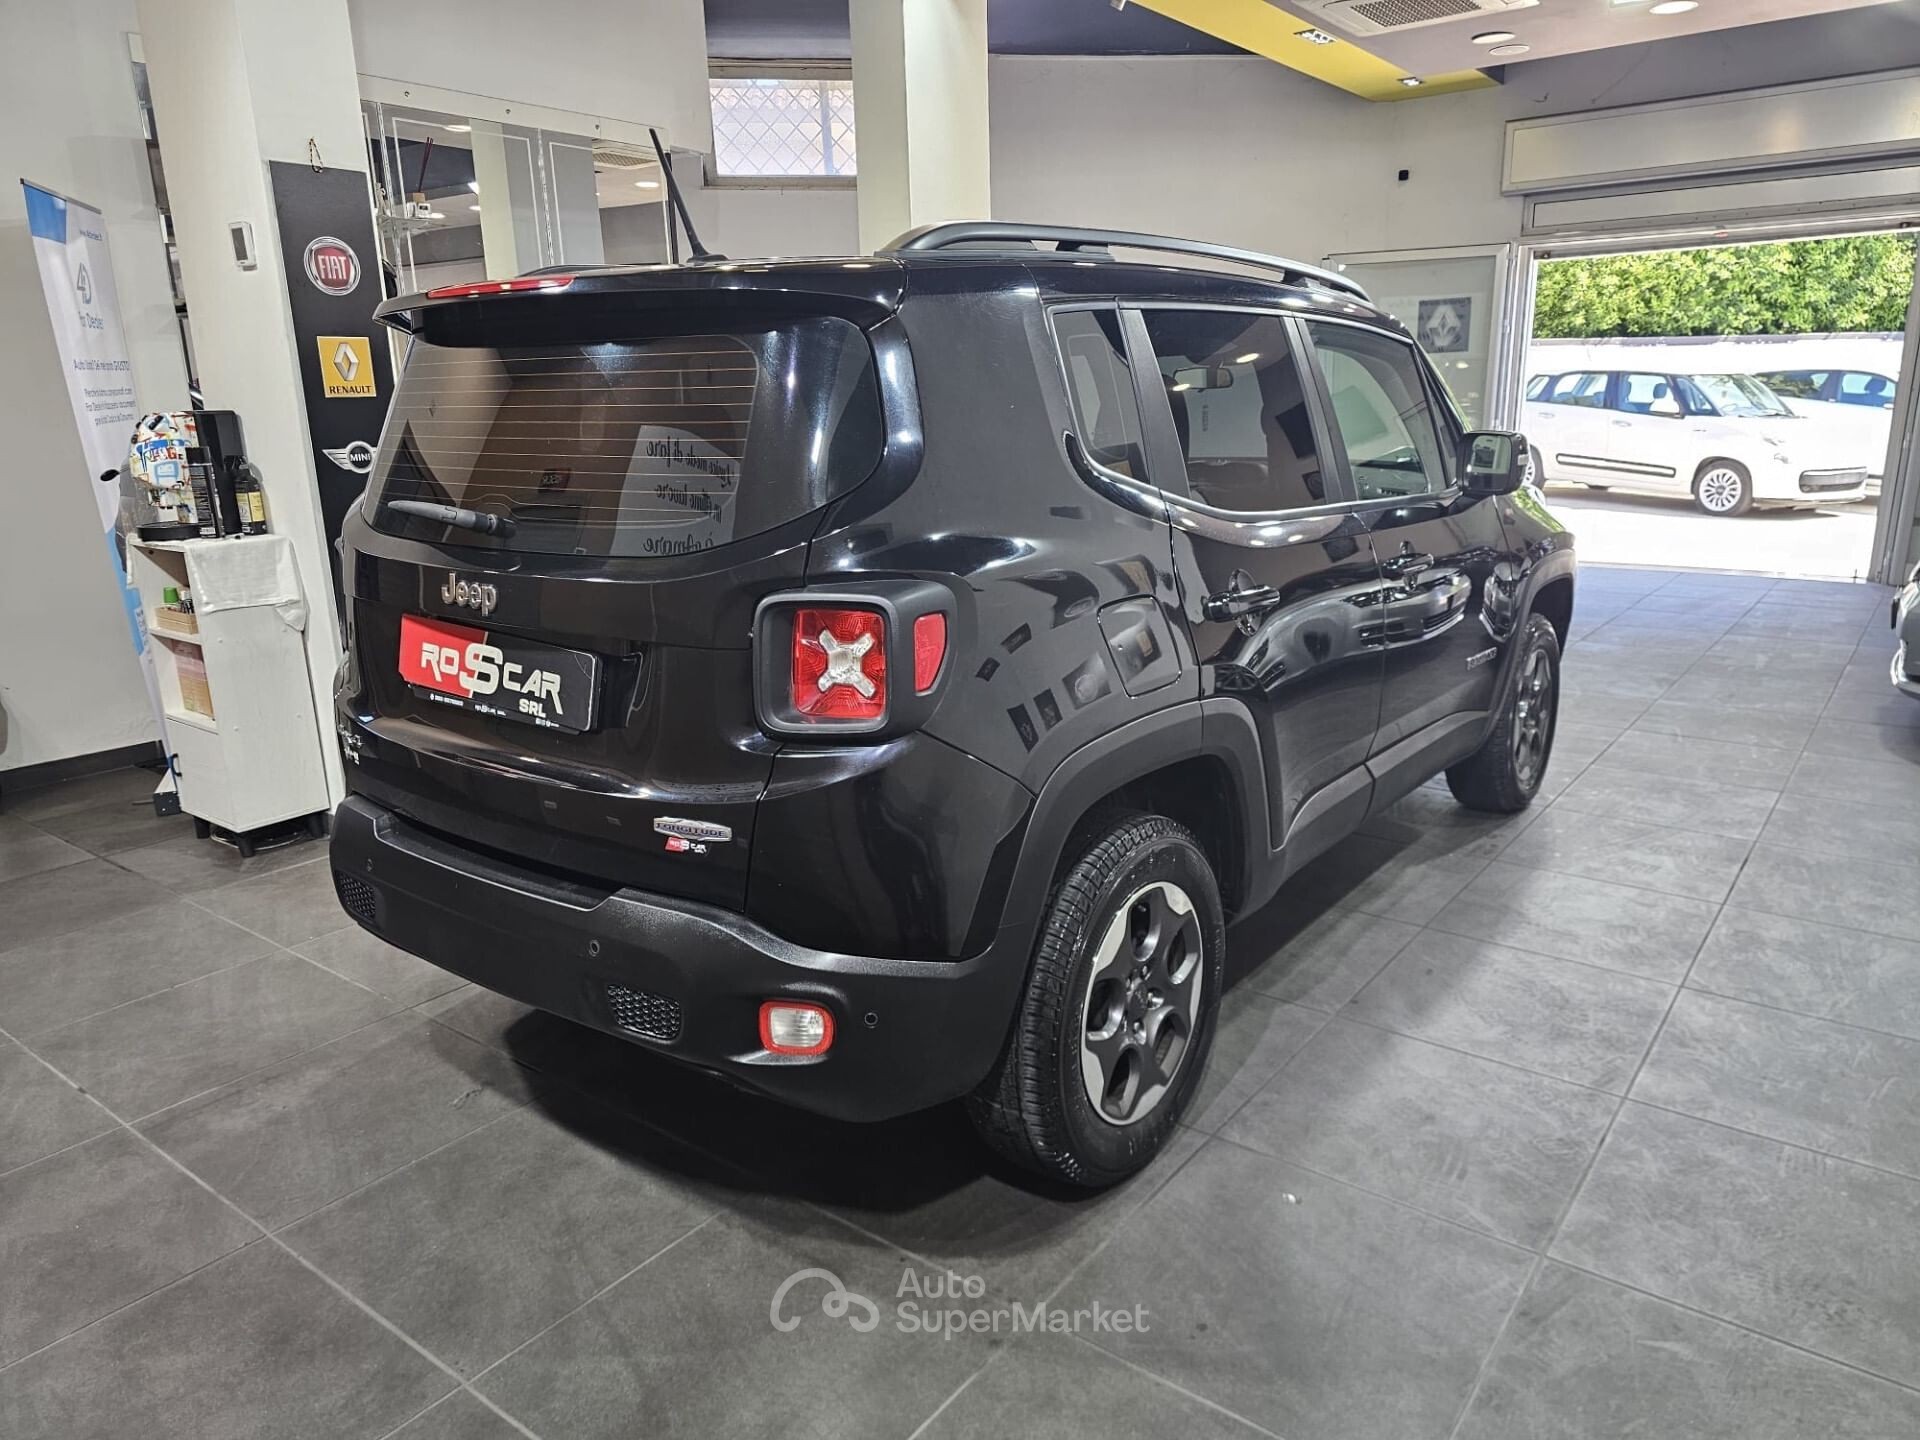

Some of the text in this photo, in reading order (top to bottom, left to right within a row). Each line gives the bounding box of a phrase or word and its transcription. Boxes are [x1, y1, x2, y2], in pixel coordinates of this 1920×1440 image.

[317, 254, 350, 281] FIAT
[329, 384, 373, 395] RENAULT
[350, 451, 371, 463] MINI
[441, 572, 498, 617] Jeep
[518, 698, 547, 718] SRL
[655, 822, 726, 838] LONGITUDE
